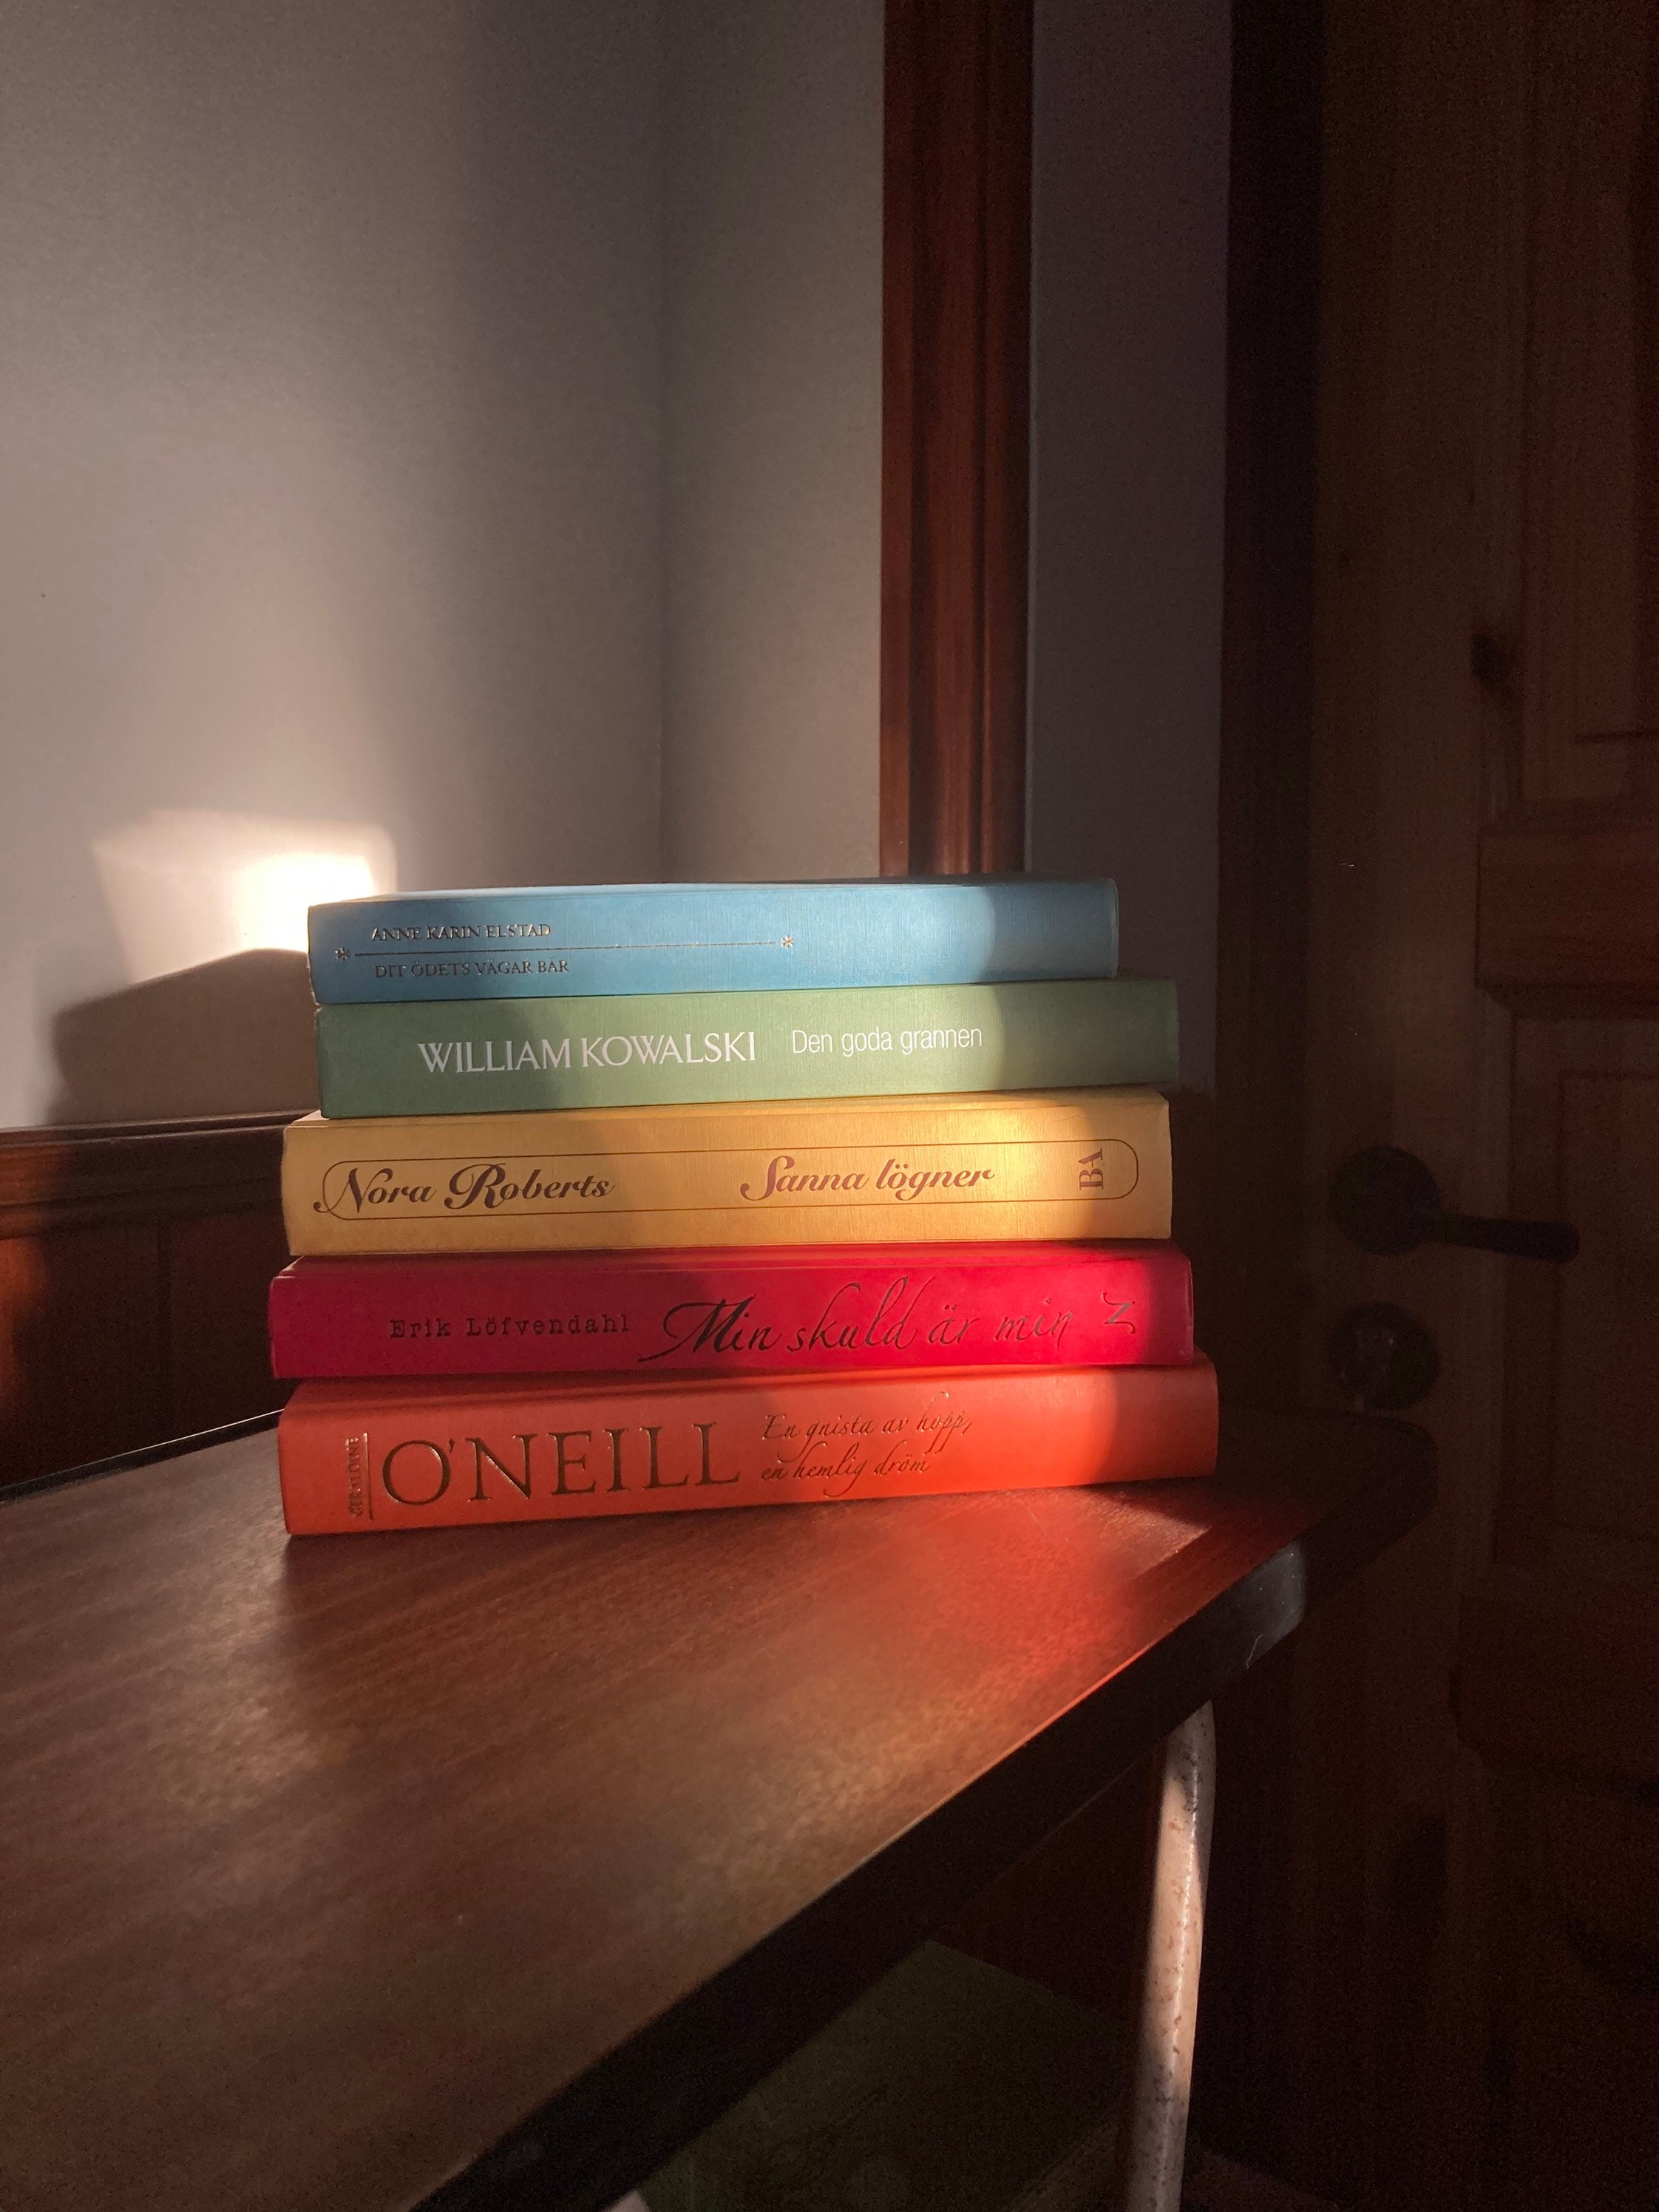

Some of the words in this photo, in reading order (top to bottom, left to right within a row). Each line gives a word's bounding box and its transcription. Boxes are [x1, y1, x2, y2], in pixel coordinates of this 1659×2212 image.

[371, 926, 421, 941] ANNE
[426, 925, 481, 940] KARIN
[485, 923, 551, 938] ELSTAD
[374, 964, 407, 978] DIT
[410, 960, 470, 977] ÖDETS
[473, 959, 532, 975] VÄGAR
[537, 957, 570, 974] BÄR
[418, 1038, 571, 1073] WILLIAM
[580, 1031, 757, 1067] KOWALSKI
[792, 1029, 833, 1054] Den
[841, 1028, 892, 1056] goda
[900, 1025, 983, 1055] grannen
[313, 1167, 437, 1213] Nora
[444, 1163, 615, 1209] Roberts
[740, 1156, 869, 1201] Sanna
[875, 1158, 995, 1201] lögner
[1078, 1147, 1105, 1190] BA
[390, 1318, 451, 1338] Erik
[467, 1313, 629, 1337] Löfvendahl
[637, 1292, 782, 1363] Min
[787, 1276, 937, 1352] skuld
[928, 1303, 980, 1345] är
[994, 1297, 1073, 1349] min
[761, 1414, 799, 1440] En
[777, 1414, 878, 1464] gnista
[881, 1417, 910, 1435] av
[345, 1436, 364, 1518] GERALDINE
[381, 1422, 740, 1506] O'NEILL
[761, 1465, 789, 1481] en
[793, 1441, 868, 1498] hemlig
[874, 1439, 932, 1476] dröm
